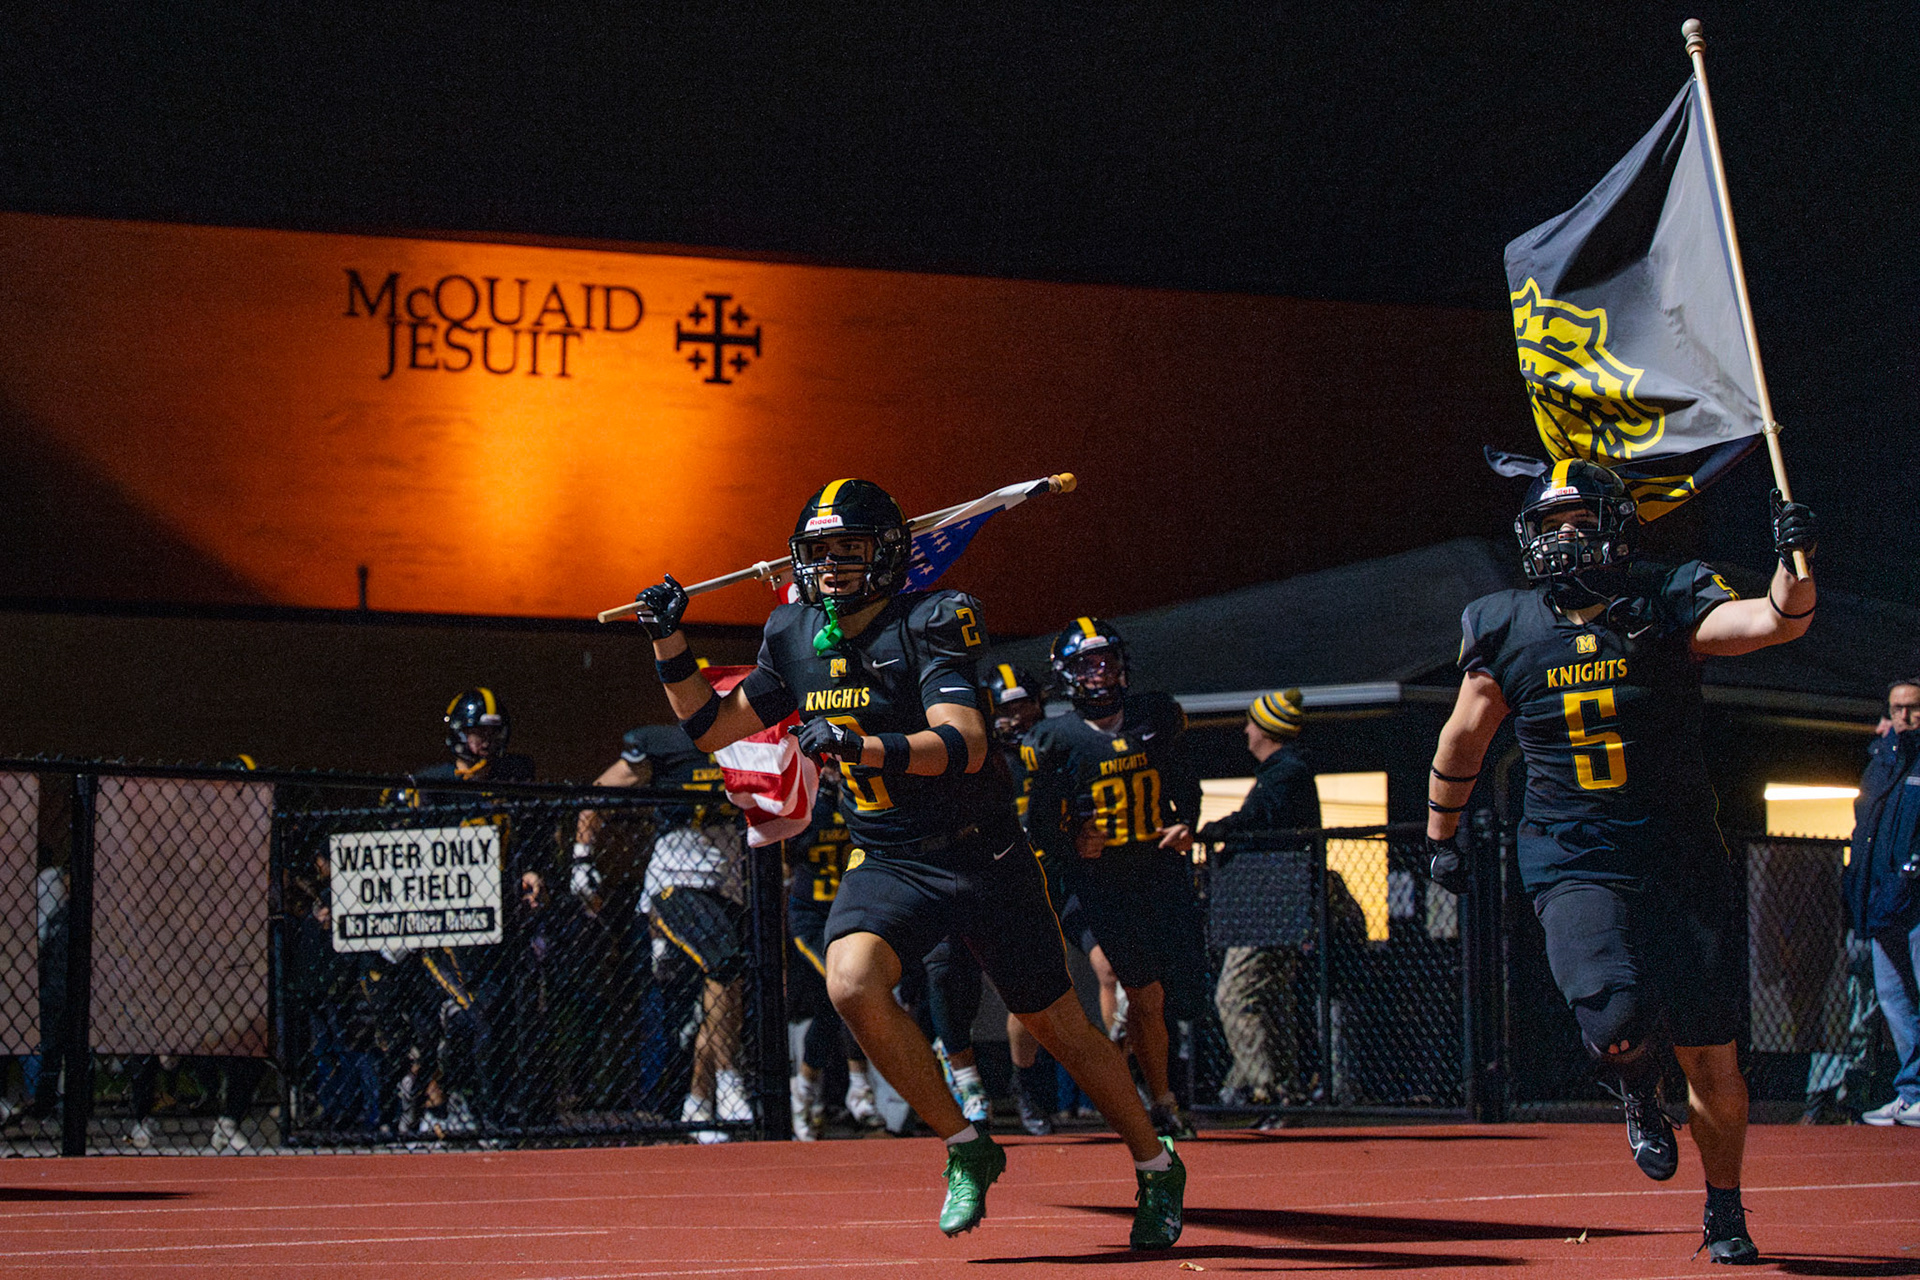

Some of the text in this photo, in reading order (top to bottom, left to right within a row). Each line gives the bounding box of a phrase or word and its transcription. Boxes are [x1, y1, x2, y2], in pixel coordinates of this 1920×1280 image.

[343, 268, 644, 333] McQUAID
[380, 319, 581, 380] JESUIT
[810, 517, 838, 526] Riddell
[955, 607, 982, 647] 2
[1576, 634, 1597, 654] M
[830, 658, 846, 678] M
[1547, 658, 1628, 688] KNIGHTS
[805, 687, 870, 711] KNIGHTS
[1563, 688, 1628, 790] 5
[1100, 752, 1148, 776] KNIGHTS
[338, 839, 491, 871] WATER ONLY
[360, 874, 471, 904] ON FIELD
